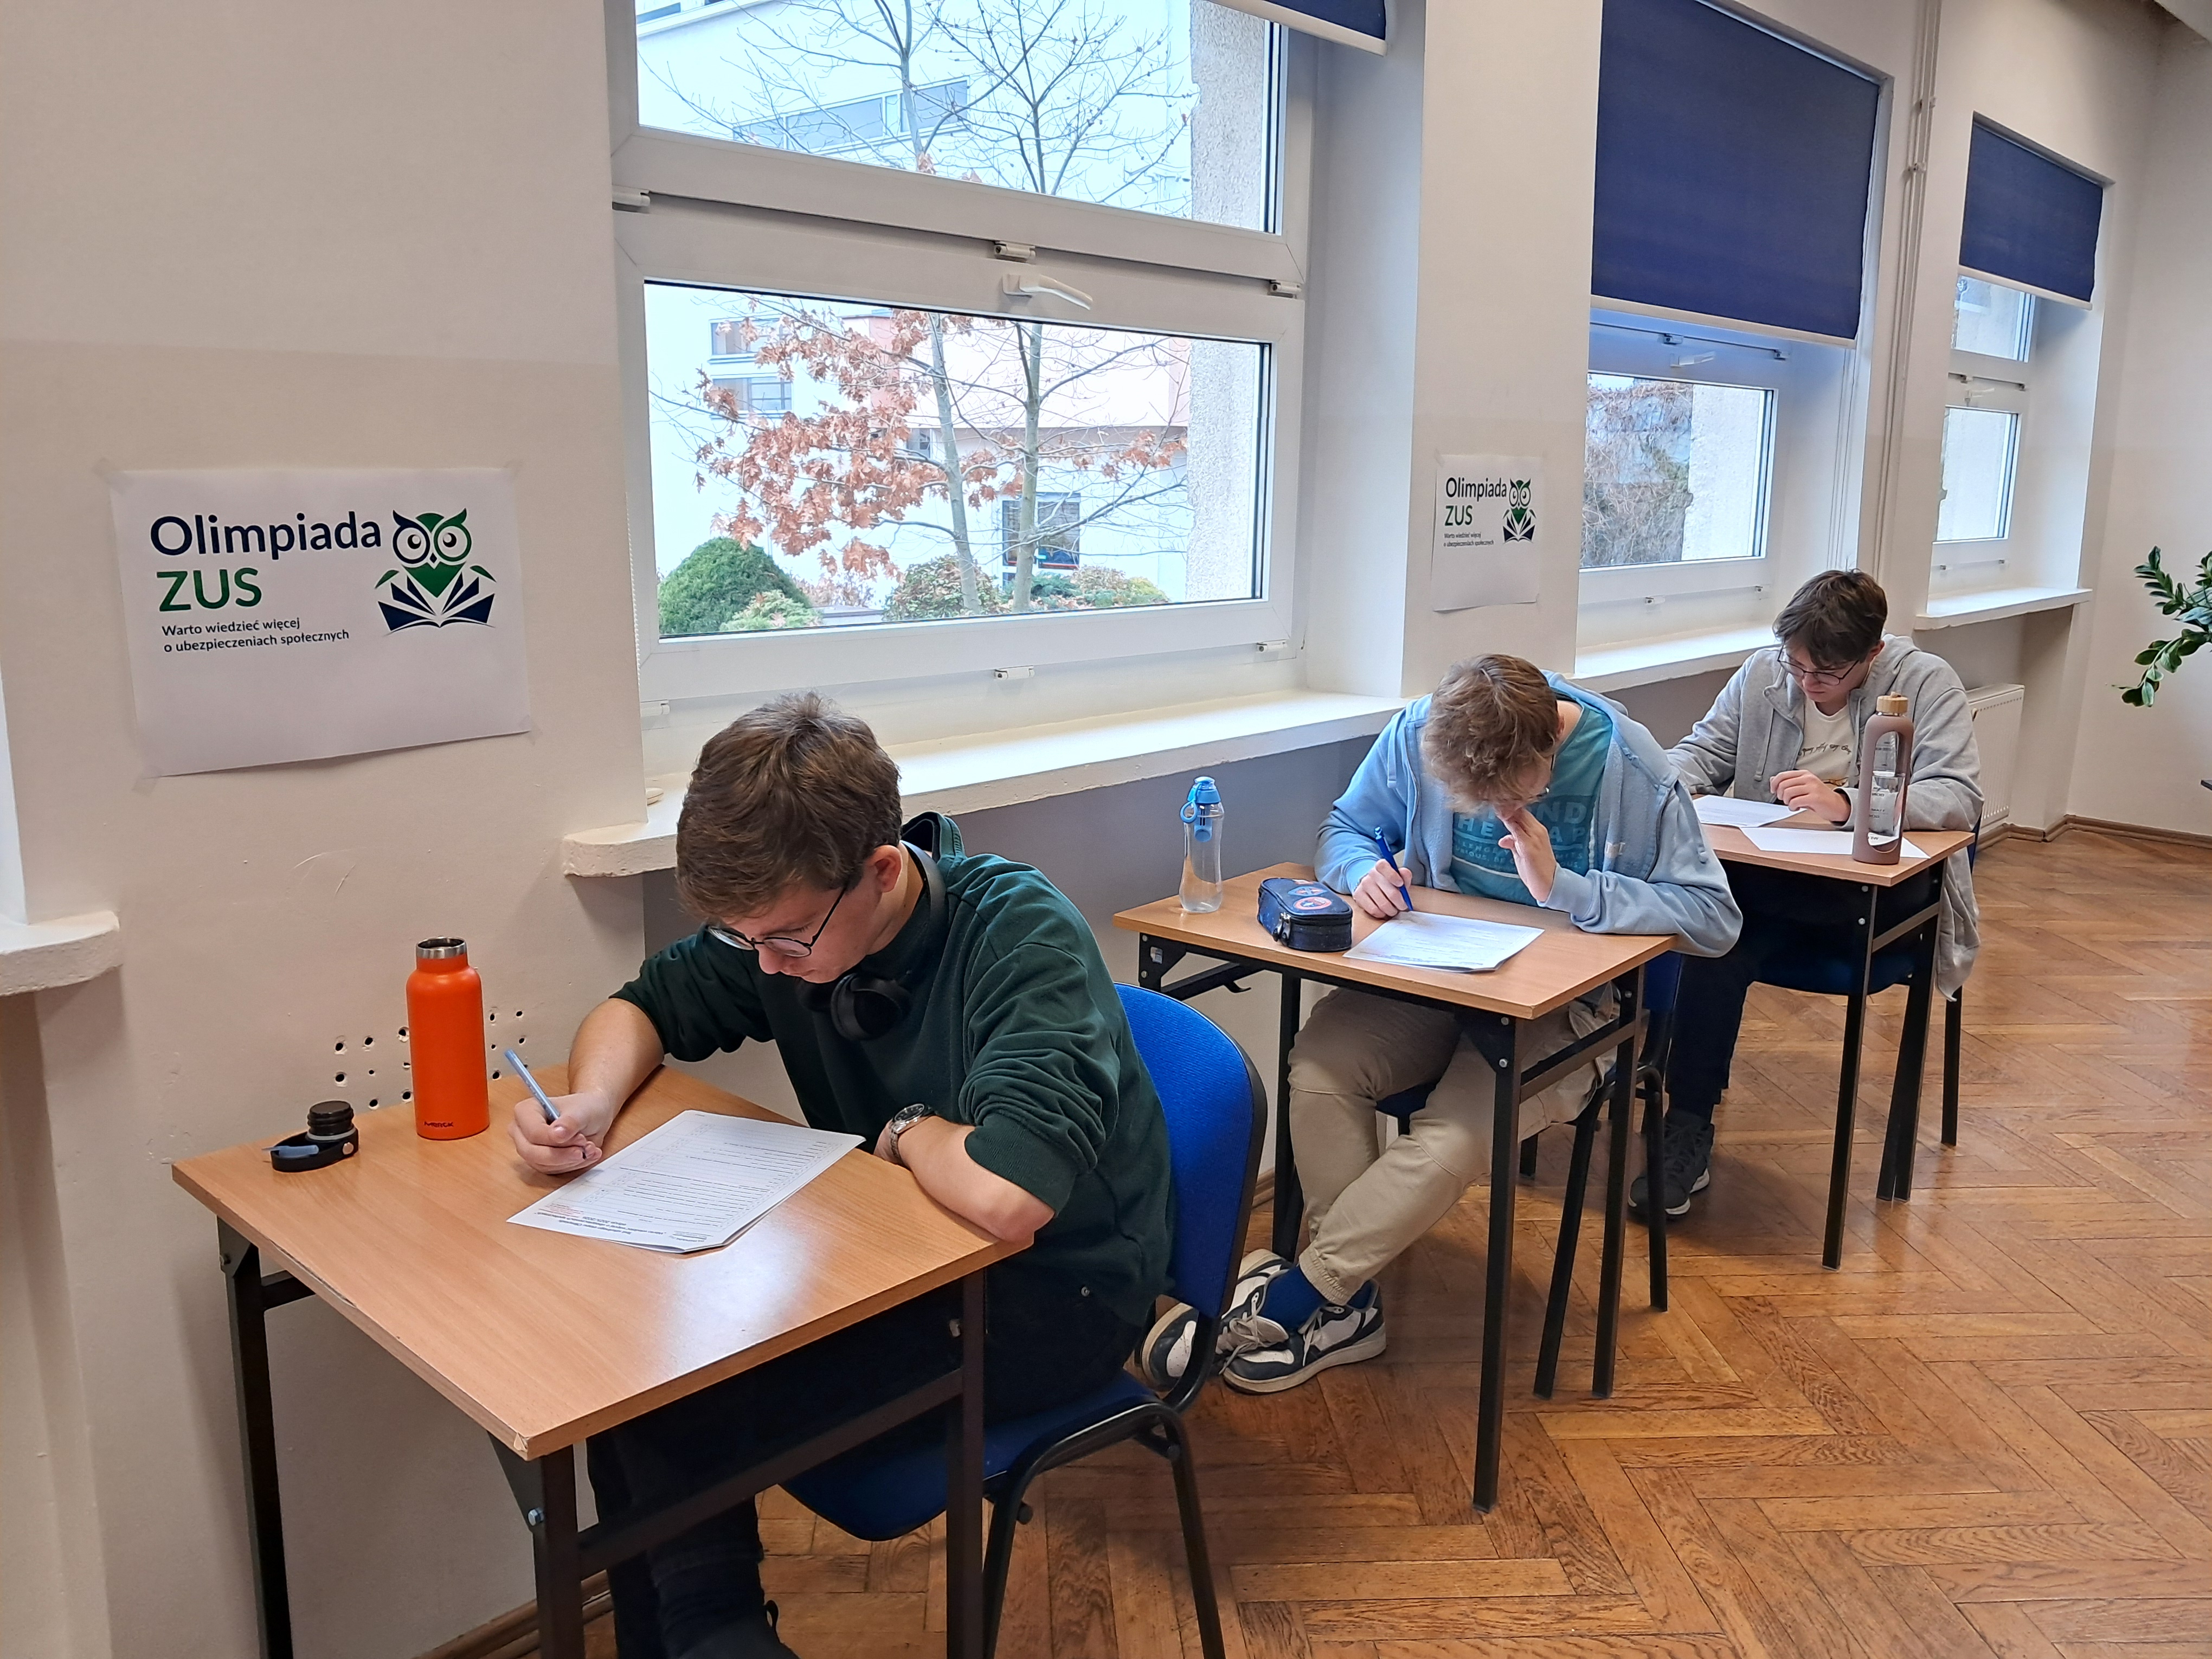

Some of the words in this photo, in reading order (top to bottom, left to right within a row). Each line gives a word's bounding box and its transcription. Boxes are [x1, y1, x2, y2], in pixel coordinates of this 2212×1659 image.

[1446, 477, 1507, 501] Olimpiada
[1445, 505, 1473, 526] ZUS
[150, 511, 381, 560] Olimpiada
[156, 567, 262, 612] ZUS
[162, 625, 202, 636] Warto
[205, 620, 260, 633] wiedzieć
[262, 618, 300, 630] więcej
[164, 644, 172, 652] o
[176, 634, 278, 651] ubezpieczeniach
[280, 629, 350, 646] społecznych
